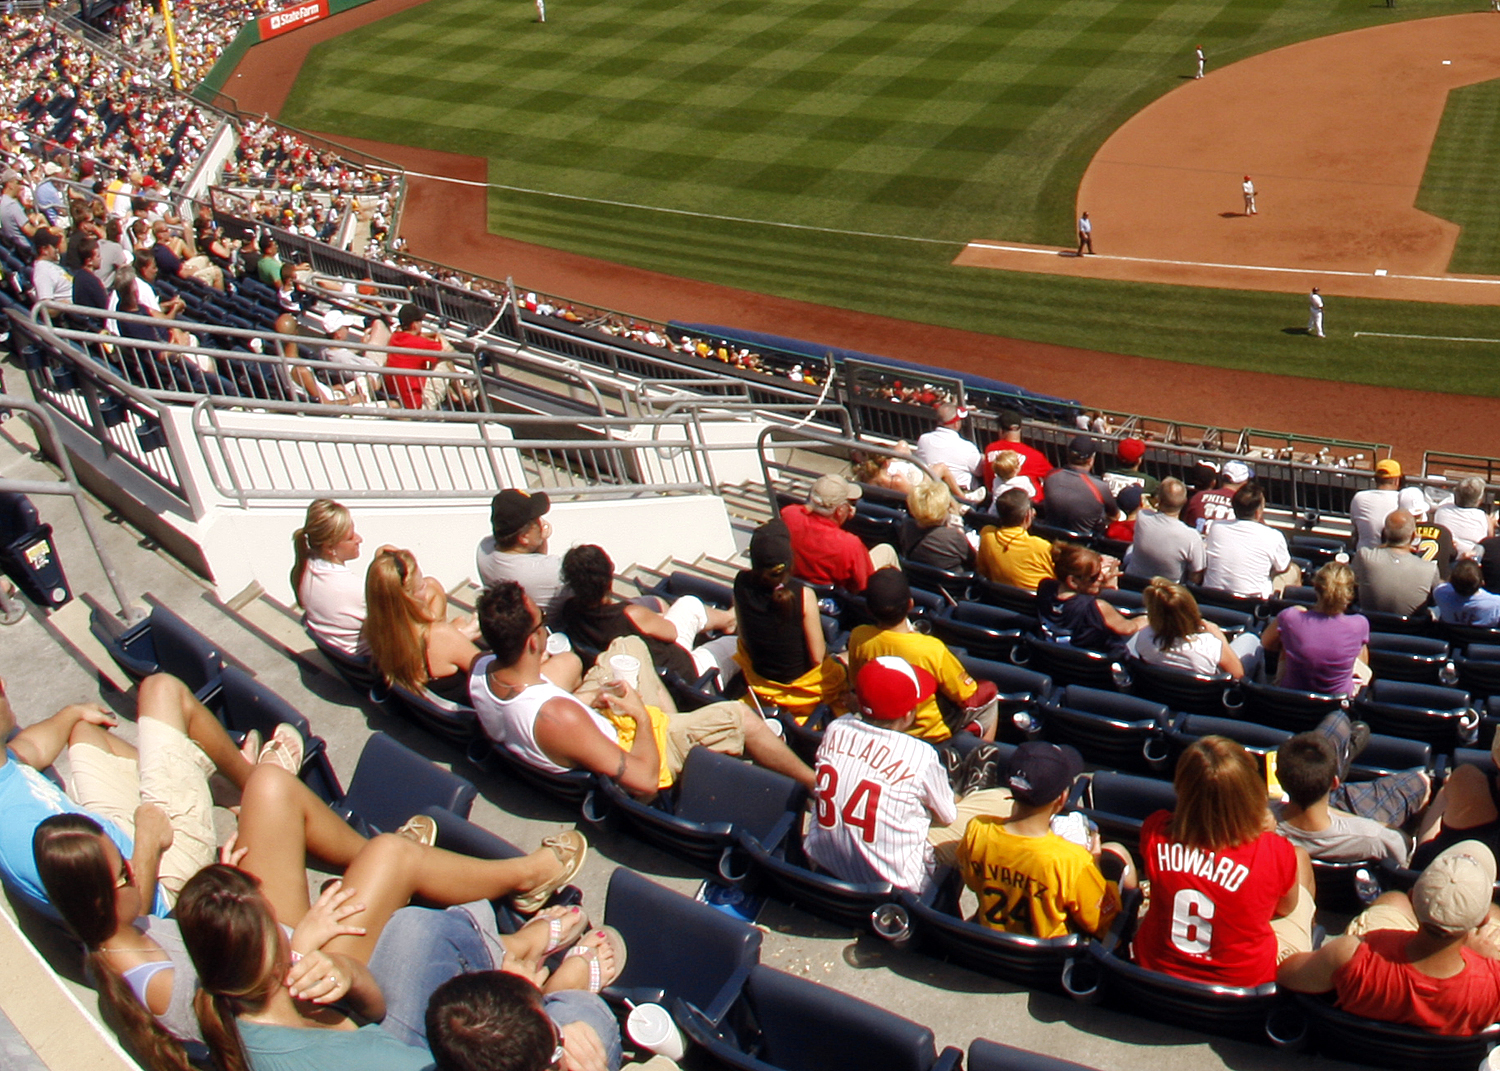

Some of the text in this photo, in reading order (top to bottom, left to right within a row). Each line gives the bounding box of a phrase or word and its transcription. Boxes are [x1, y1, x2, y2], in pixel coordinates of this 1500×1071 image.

[816, 729, 916, 787] HALLADAY
[815, 763, 883, 844] 34
[970, 861, 1049, 901] ALVAREZ
[1157, 842, 1250, 893] HOWARD
[983, 885, 1034, 936] 24
[1171, 888, 1216, 955] 6
